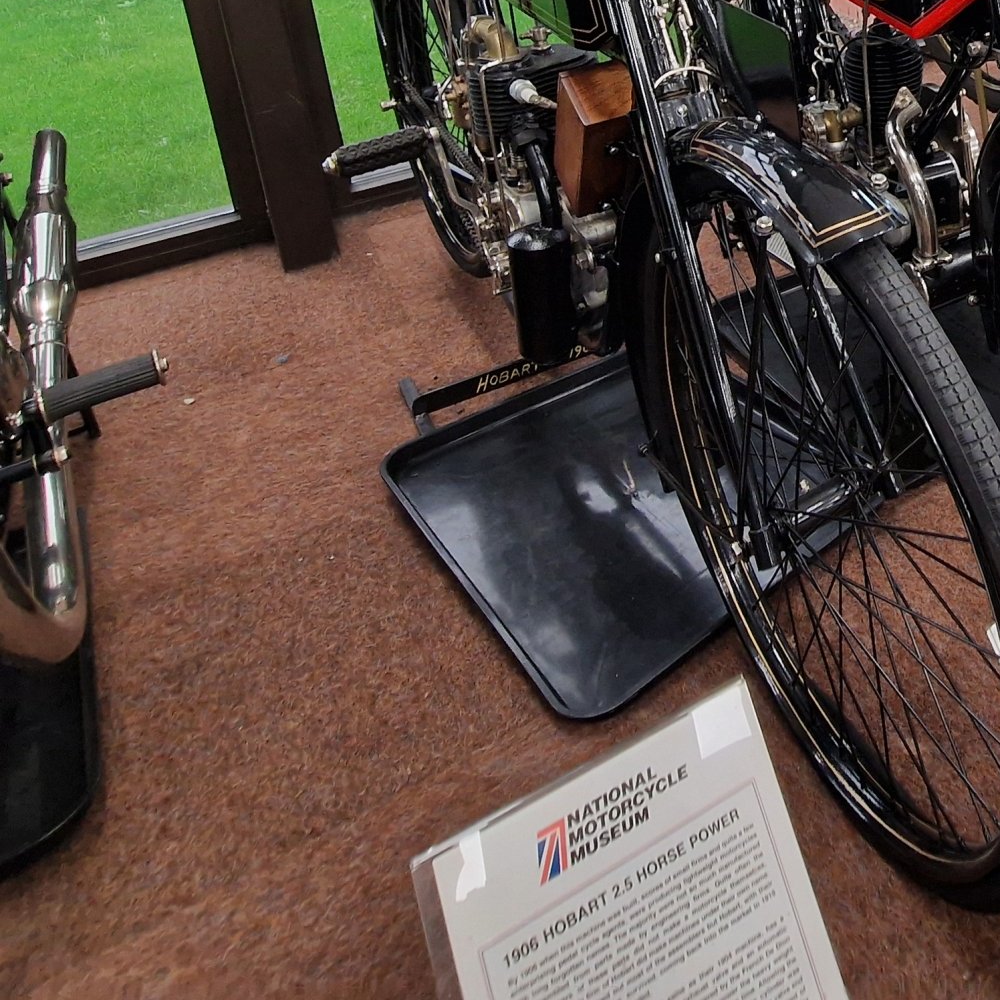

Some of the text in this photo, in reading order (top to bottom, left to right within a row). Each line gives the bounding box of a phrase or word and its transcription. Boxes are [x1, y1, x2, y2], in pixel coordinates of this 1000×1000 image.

[567, 765, 658, 830] NATIONAL
[568, 763, 689, 848] MOTORCYCLE
[569, 808, 650, 867] MUSEUM
[503, 807, 739, 968] 1906 HOBART 2.5 HORSE POWER
[550, 959, 585, 984] forgotten
[628, 911, 656, 932] majority
[718, 841, 760, 873] manufactured
[575, 920, 606, 942] machine
[641, 882, 664, 900] scores
[580, 936, 599, 952] cycle
[647, 883, 681, 909] producing
[682, 857, 718, 884] lightweight
[719, 832, 757, 860] motorcycles
[650, 901, 691, 931] engineering
[691, 887, 727, 915] motorcycle
[730, 905, 752, 925] market
[610, 962, 634, 982] Hobart
[668, 918, 700, 943] machines
[701, 905, 720, 921] under
[667, 927, 705, 956] assemblers
[741, 953, 764, 973] French
